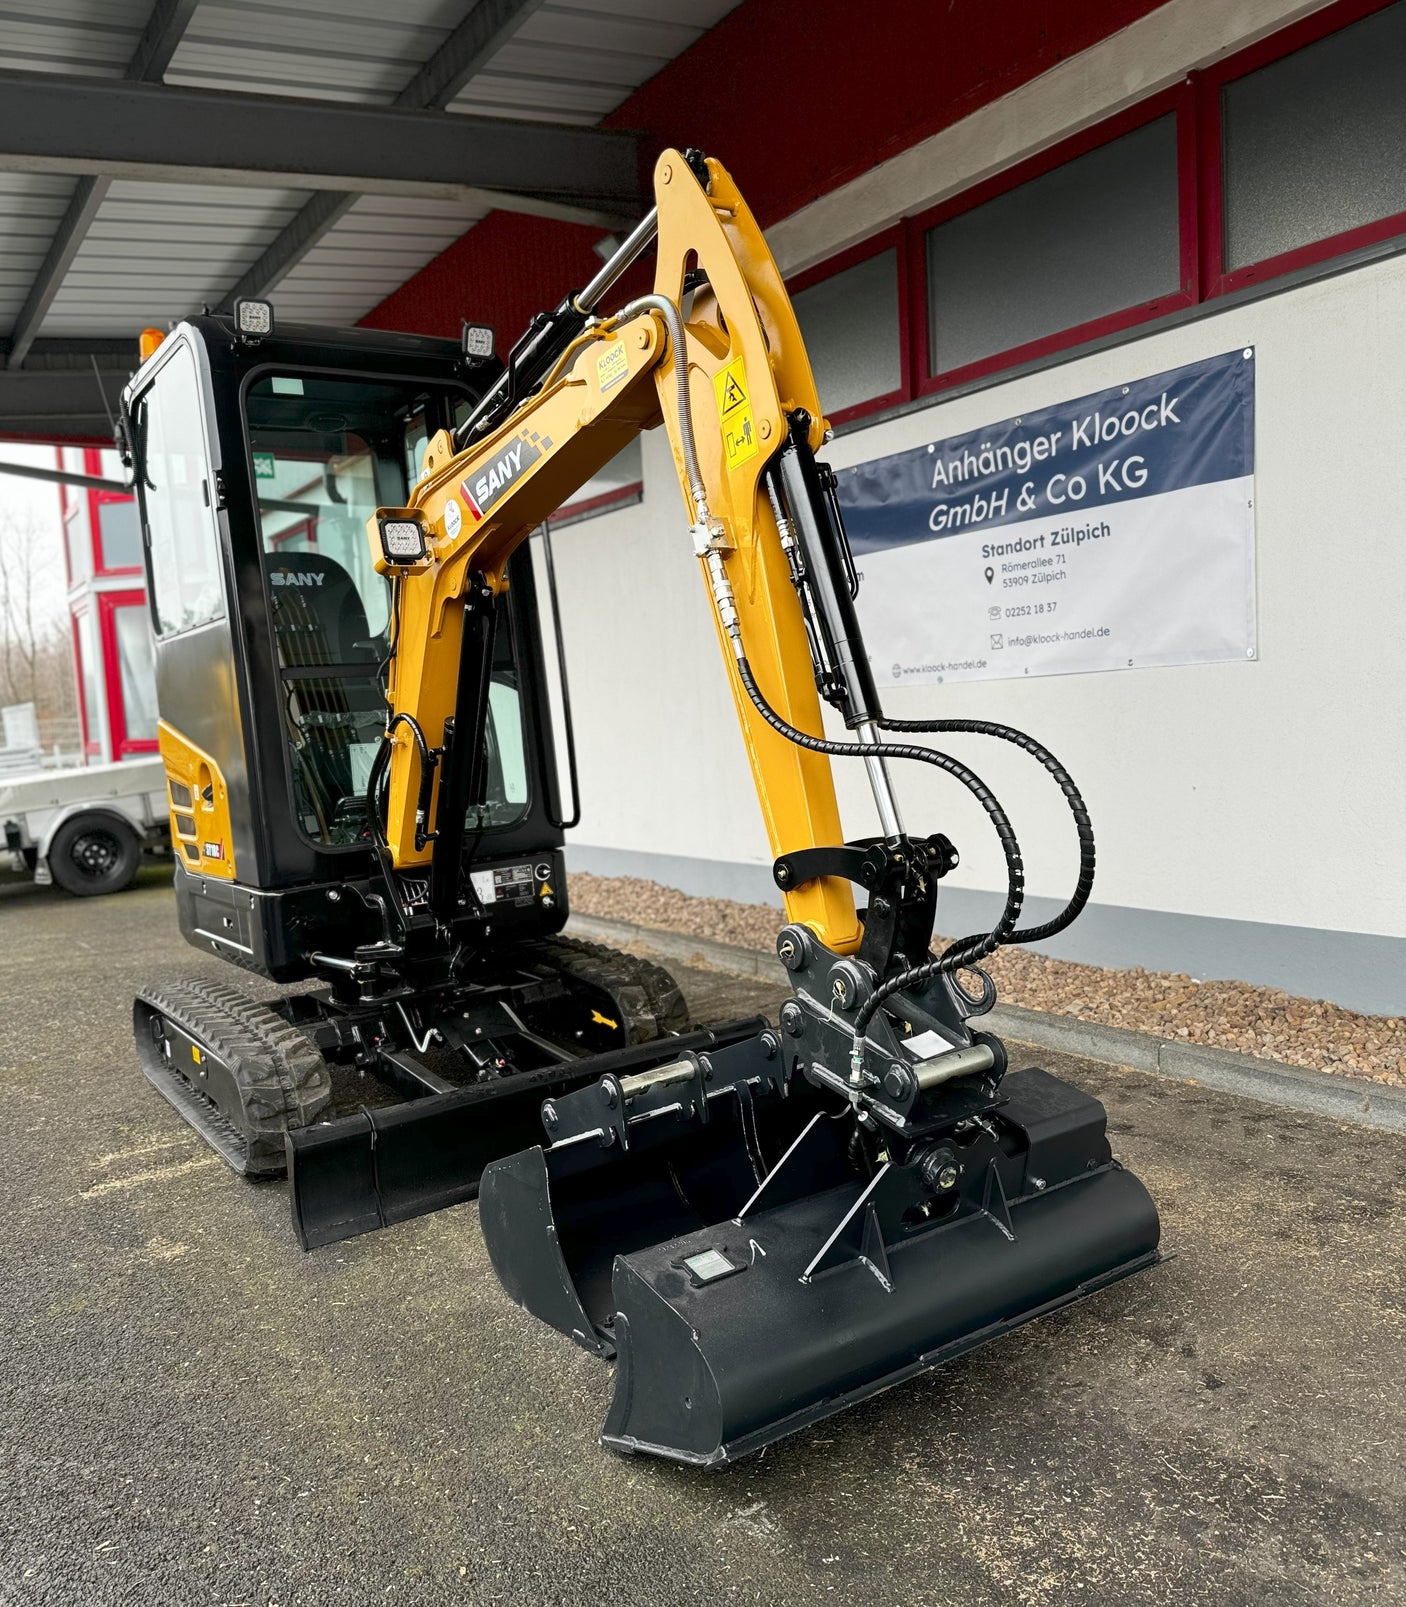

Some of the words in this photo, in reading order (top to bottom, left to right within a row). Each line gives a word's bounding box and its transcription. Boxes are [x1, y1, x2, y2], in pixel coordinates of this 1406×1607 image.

[931, 430, 1062, 489] Anhänger
[1071, 392, 1182, 451] Kloock
[475, 442, 522, 506] SANY
[928, 487, 1009, 532] GmbH
[1016, 481, 1037, 513] &
[1046, 473, 1087, 505] Co
[1098, 455, 1149, 495] KG
[981, 534, 1046, 559] Standort
[1050, 521, 1112, 547] Zülpich
[1001, 557, 1054, 574] Römerallee
[1056, 553, 1067, 565] 71
[270, 572, 325, 586] SANY
[1002, 575, 1029, 589] 53909
[1032, 569, 1067, 584] Zülpich
[1005, 605, 1032, 618] 02252
[1034, 603, 1044, 614] 18
[1046, 601, 1058, 612] 37
[1007, 626, 1111, 647] info@kloock-handel.de
[902, 658, 988, 675] www.kloock-handel.de
